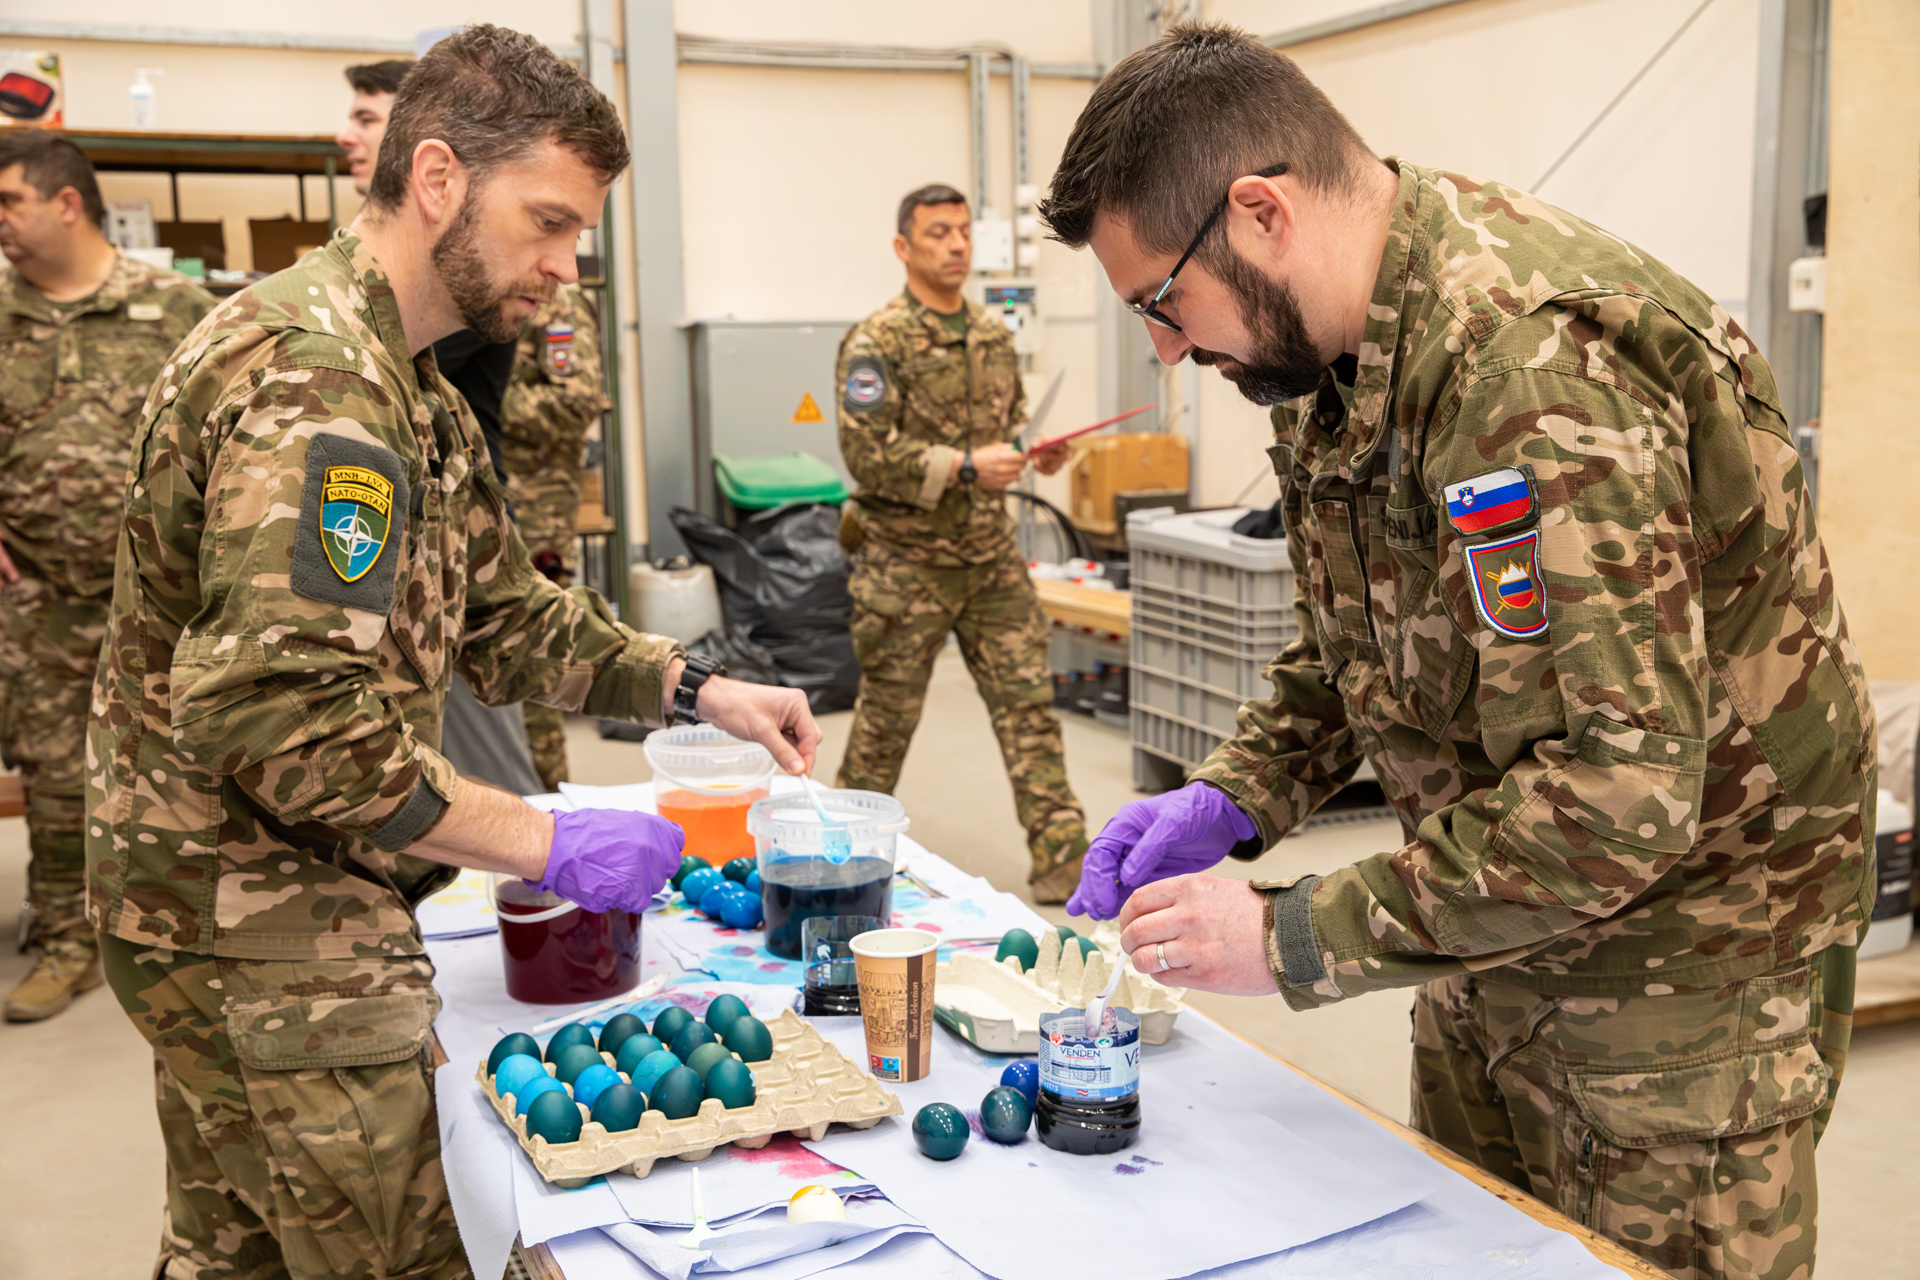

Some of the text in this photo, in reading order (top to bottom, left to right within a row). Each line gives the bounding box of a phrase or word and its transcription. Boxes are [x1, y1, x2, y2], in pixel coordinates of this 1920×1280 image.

[329, 490, 386, 509] NATO-OTAN
[909, 981, 919, 1017] Selection
[1060, 1046, 1101, 1058] VENDEN
